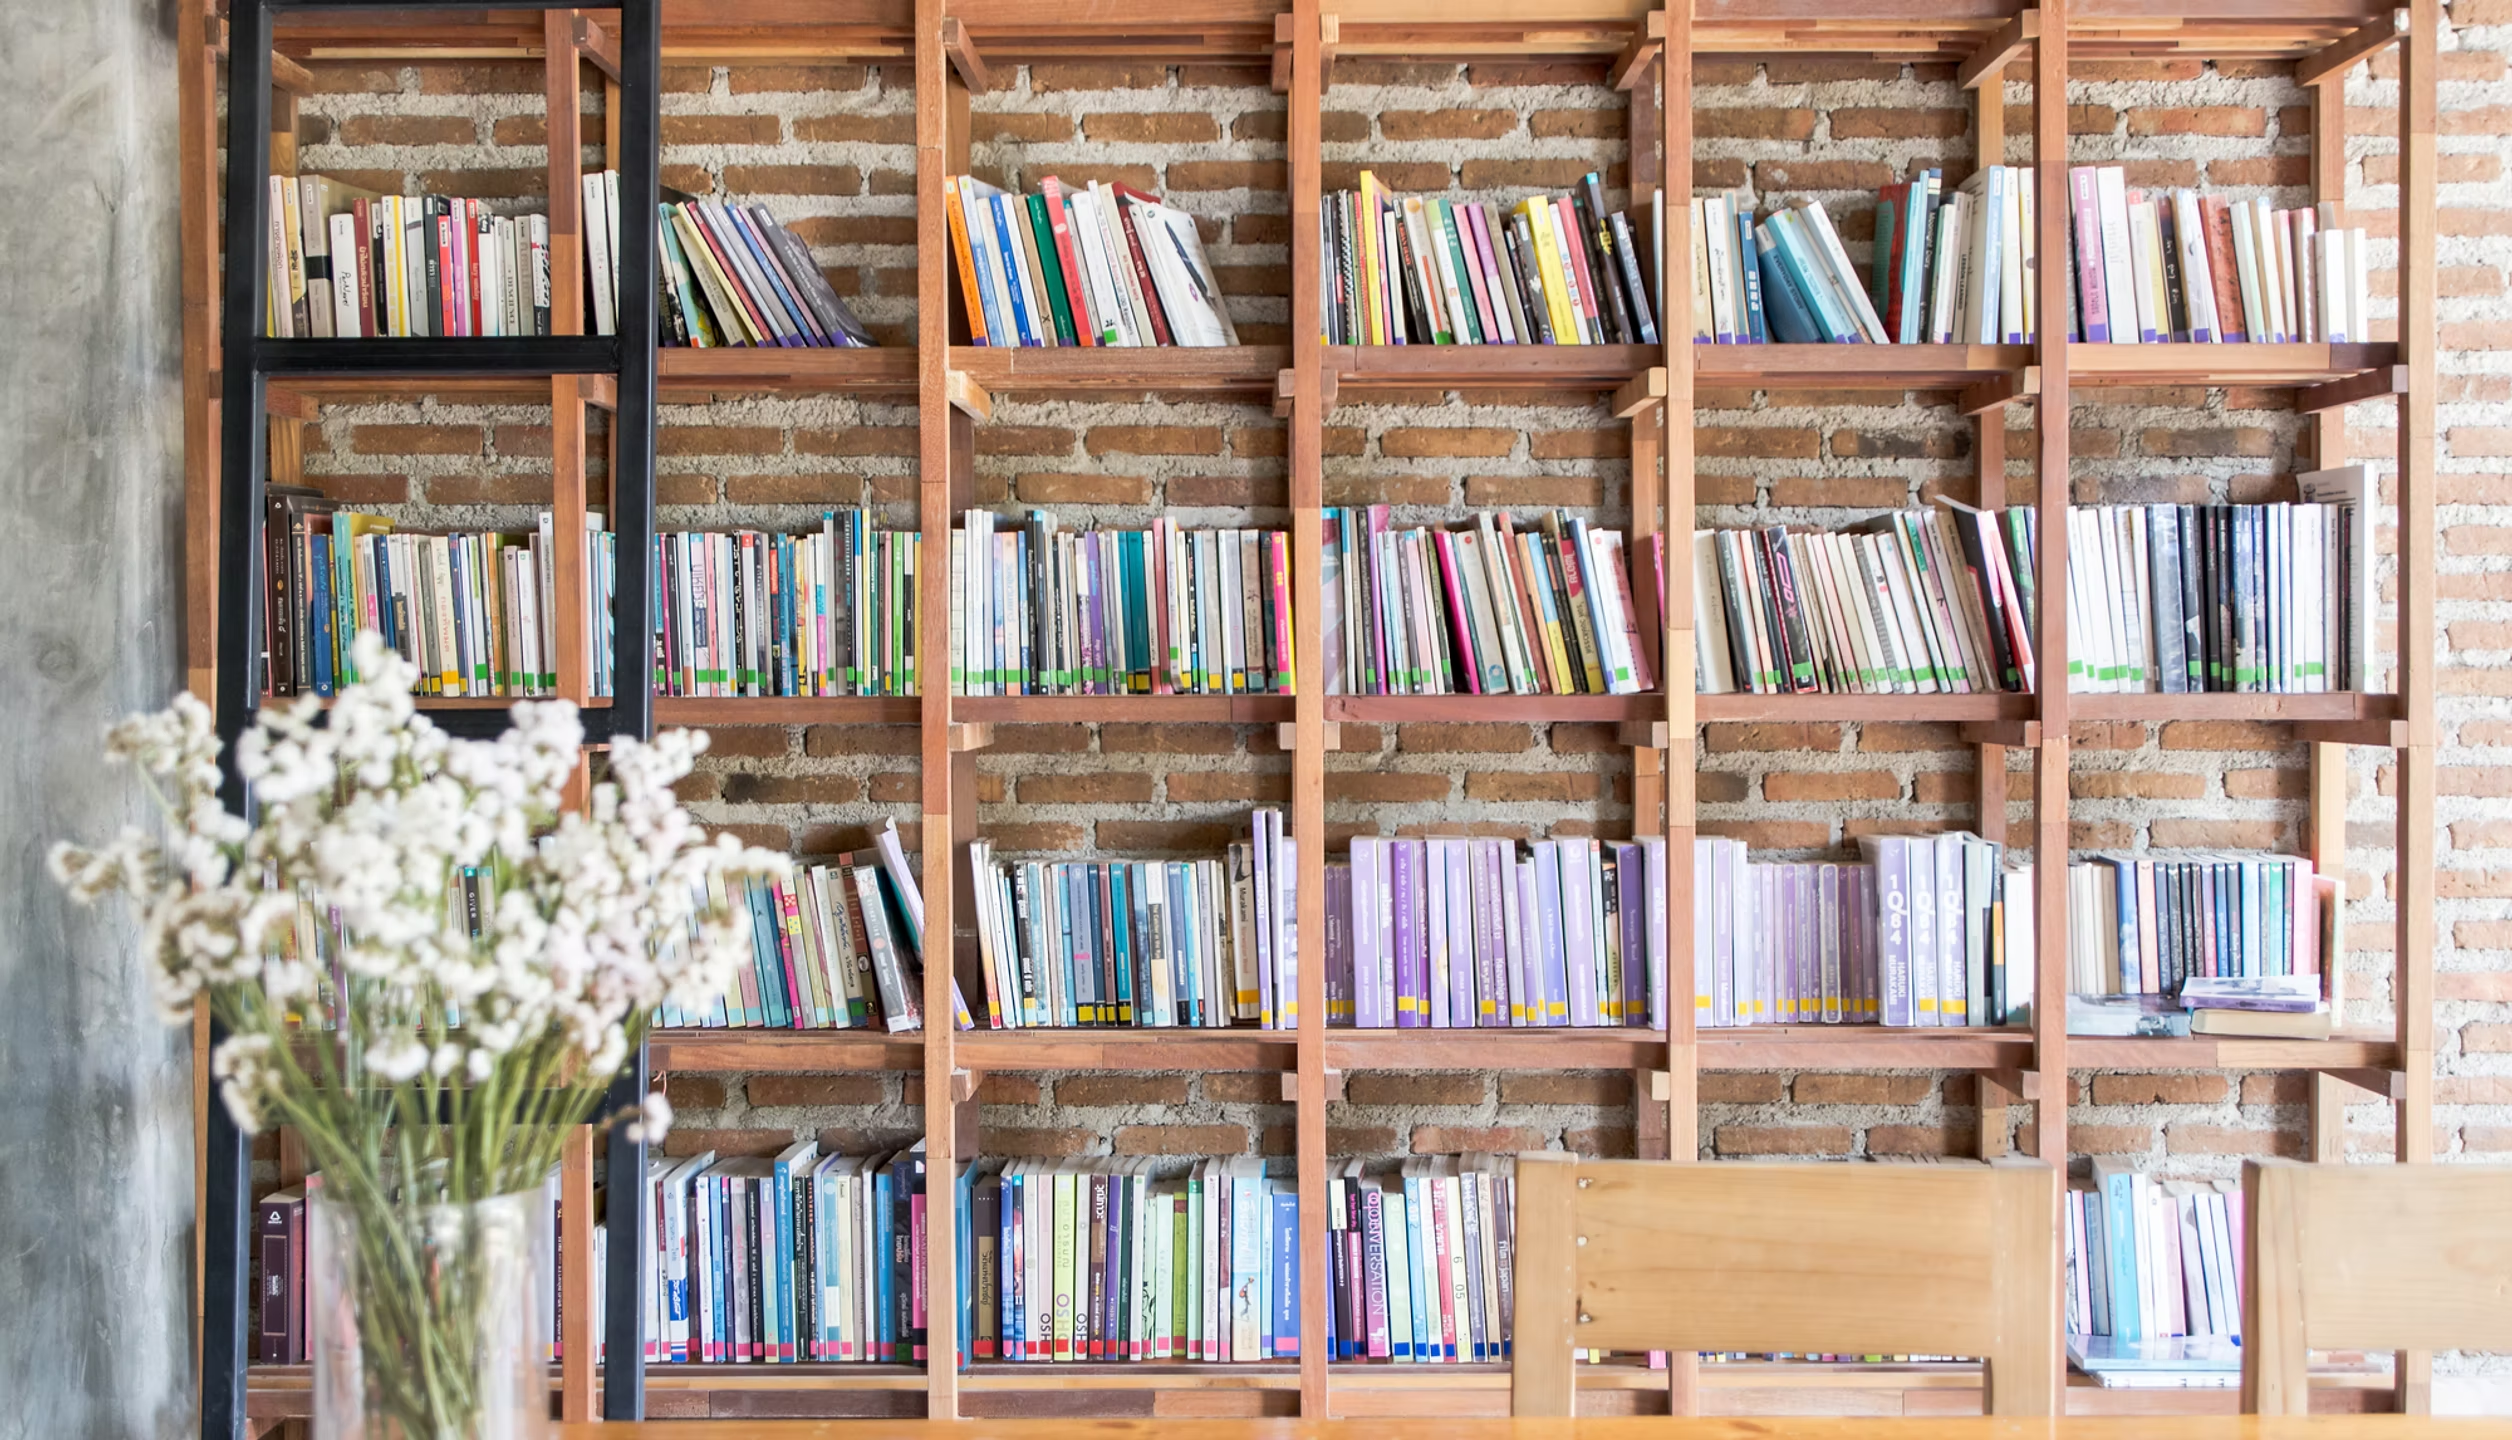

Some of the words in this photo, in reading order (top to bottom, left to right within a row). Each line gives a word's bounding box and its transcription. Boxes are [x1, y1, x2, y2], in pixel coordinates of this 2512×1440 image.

[1925, 212, 1937, 248] Moonlight
[1924, 249, 1934, 269] Diary
[1959, 253, 1967, 280] LESSON
[1788, 288, 1805, 310] STORY
[469, 891, 478, 919] GIVER
[1239, 887, 1249, 923] Murakami
[1887, 873, 1908, 946] 1Q84
[1915, 873, 1937, 946] 1Q84
[1384, 957, 1394, 982] PAUL
[1888, 954, 1899, 1006] MURAKAMI
[1897, 961, 1907, 998] HARUKI
[1918, 954, 1928, 999] MURAKA
[1927, 962, 1937, 998] HARUKI
[1953, 961, 1963, 997] HARUKI
[1384, 984, 1395, 1021] AUSTER
[1720, 981, 1729, 1021] Murakami
[1453, 1256, 1463, 1264] 6
[1498, 1239, 1509, 1260] film
[1455, 1284, 1465, 1299] 05
[1498, 1265, 1511, 1293] japan
[1040, 1312, 1052, 1342] OSH
[1075, 1312, 1089, 1344] OSH
